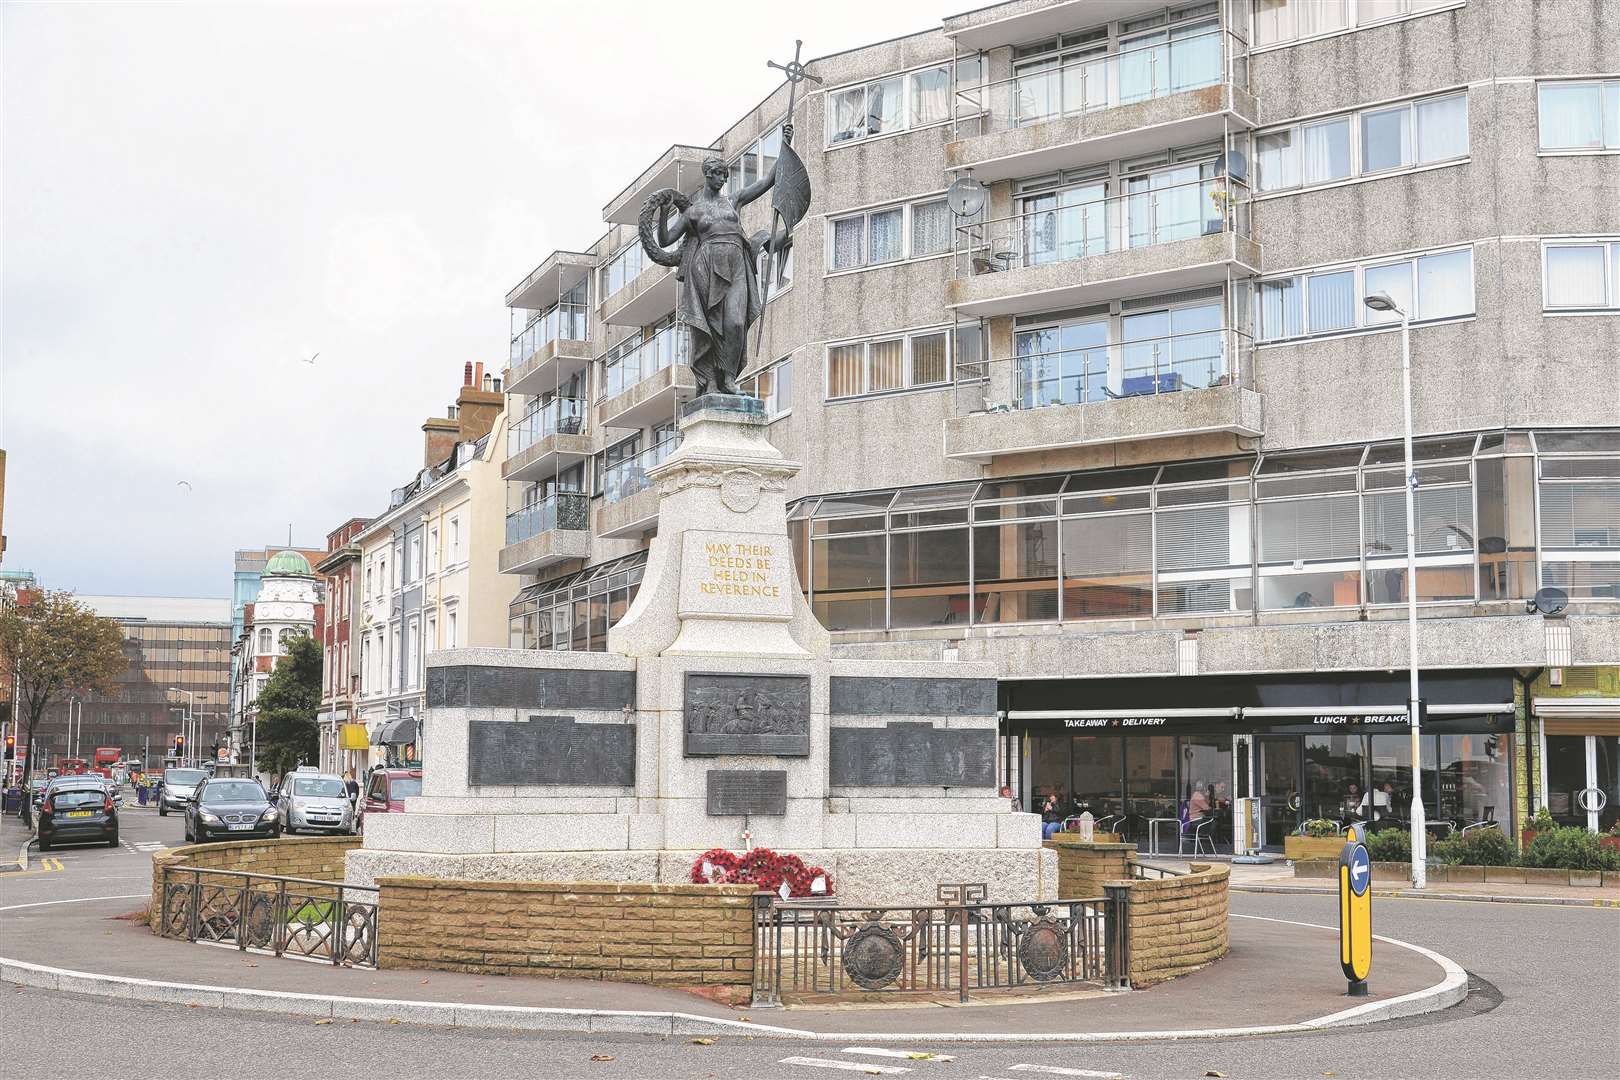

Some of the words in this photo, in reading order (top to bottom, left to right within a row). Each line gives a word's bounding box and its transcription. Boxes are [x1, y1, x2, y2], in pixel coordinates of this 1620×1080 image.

[704, 543, 731, 555] MAY
[736, 544, 773, 556] THEIR
[709, 556, 752, 568] DEEDS
[757, 559, 770, 570] BE
[714, 570, 748, 582] HELD
[752, 572, 767, 583] IN
[700, 583, 780, 597] REVERENCE
[1064, 719, 1108, 727] TAKEAWAY
[1122, 718, 1167, 726] DELIVERY
[1313, 716, 1347, 724] LUNCH
